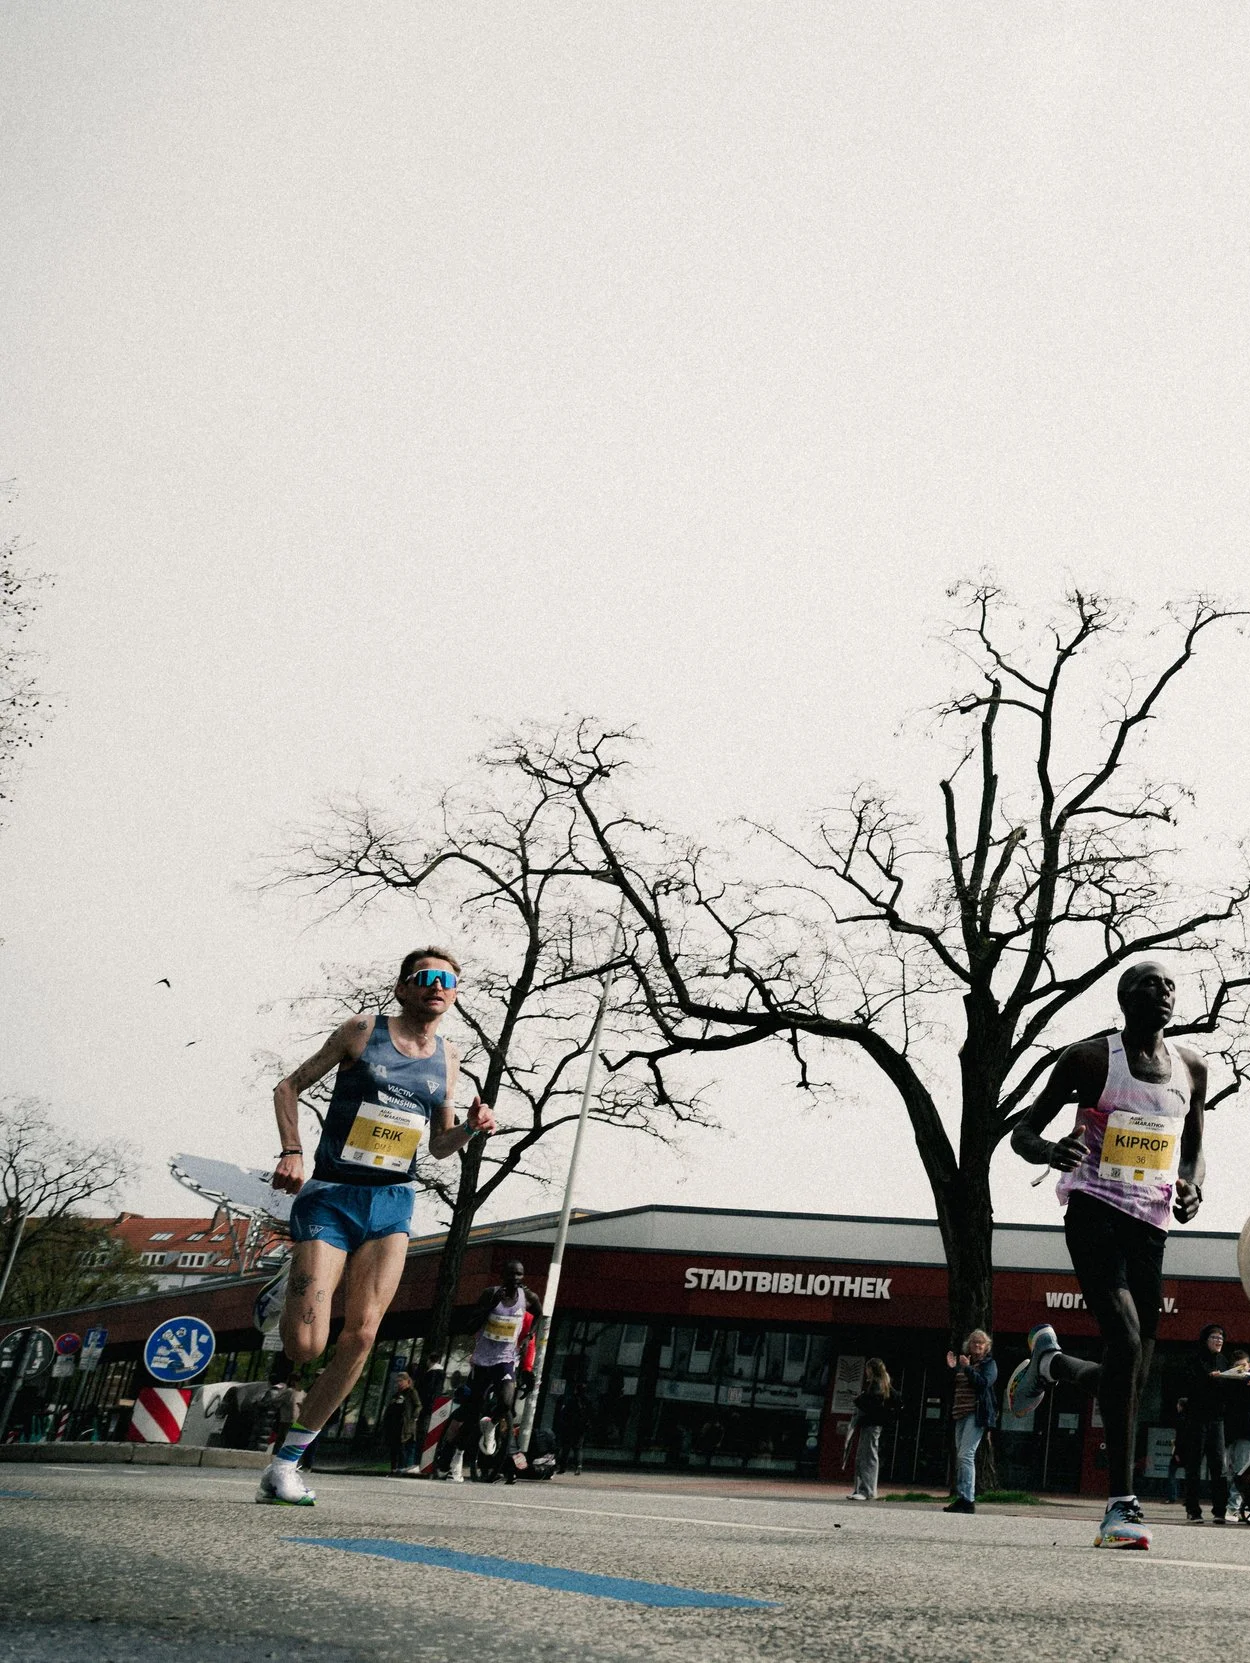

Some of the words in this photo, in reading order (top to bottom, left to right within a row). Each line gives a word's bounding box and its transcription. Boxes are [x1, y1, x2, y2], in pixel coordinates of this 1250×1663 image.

[388, 1084, 414, 1097] VIACTIV
[372, 1126, 404, 1142] ERIK
[1115, 1134, 1169, 1152] KIPROP
[1135, 1155, 1146, 1164] 36
[684, 1267, 892, 1300] STADTBIBLIOTHEK
